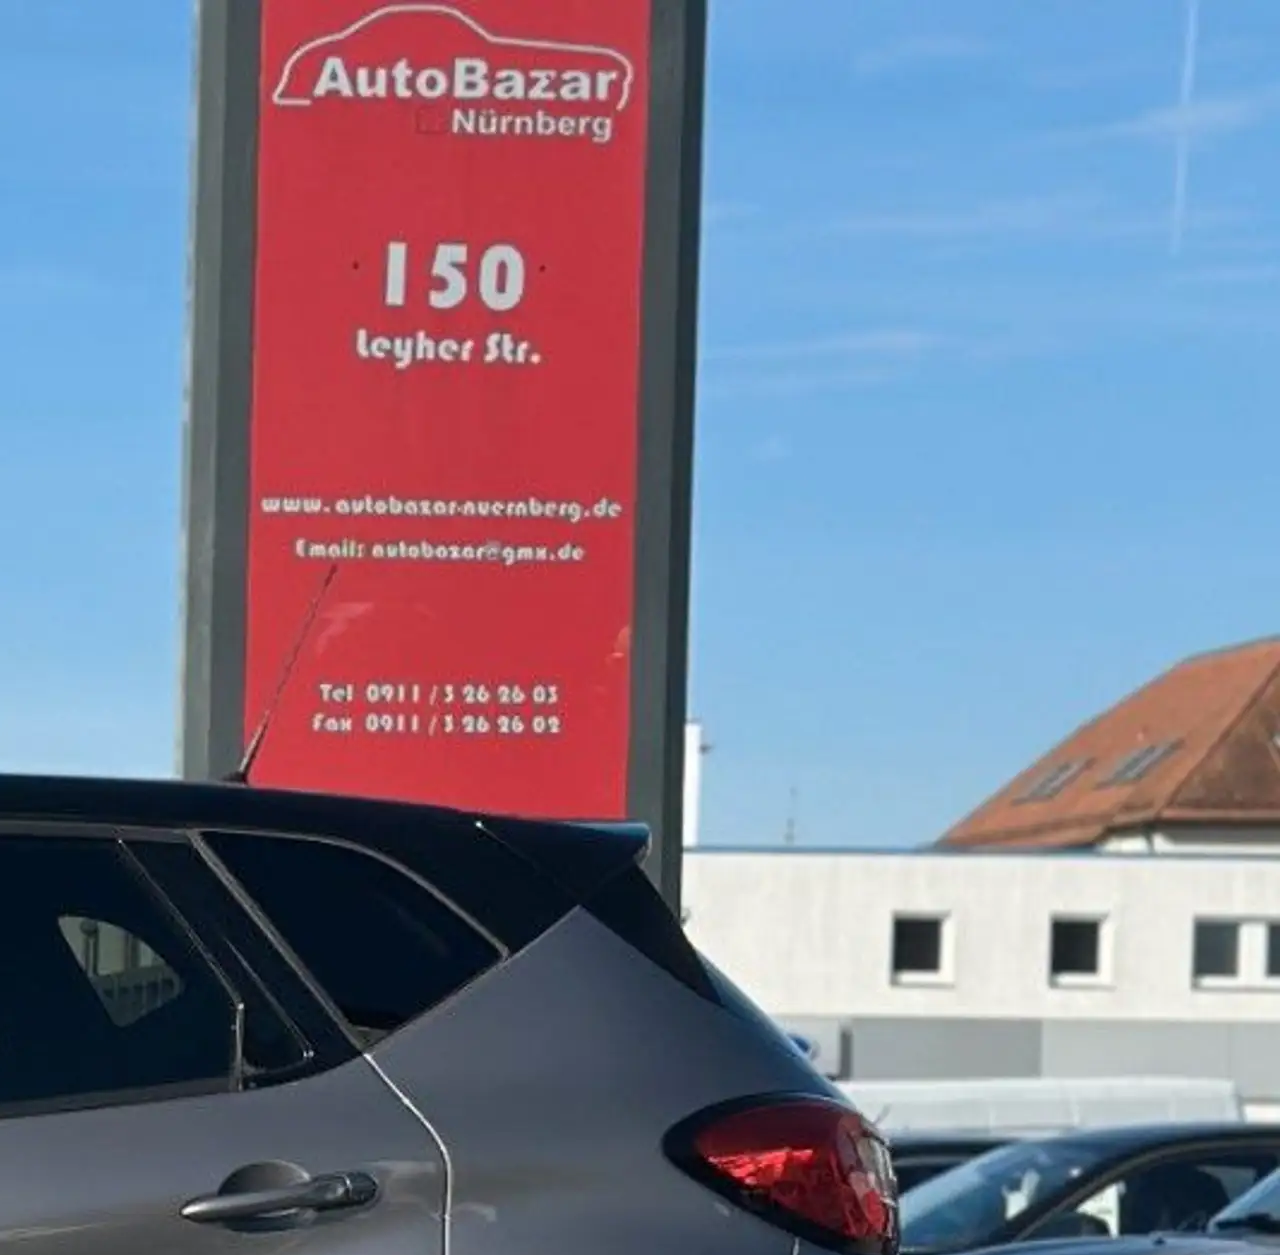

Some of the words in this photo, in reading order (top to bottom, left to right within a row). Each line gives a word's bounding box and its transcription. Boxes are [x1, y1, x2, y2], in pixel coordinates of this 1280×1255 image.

[312, 56, 618, 101] AutoBazar
[451, 107, 613, 143] Nürnberg
[356, 329, 475, 369] Leyher
[483, 332, 541, 364] Str.
[319, 683, 354, 703] Tel
[365, 683, 420, 703] 0911
[311, 712, 353, 732] Fax
[365, 713, 419, 733] 0911
